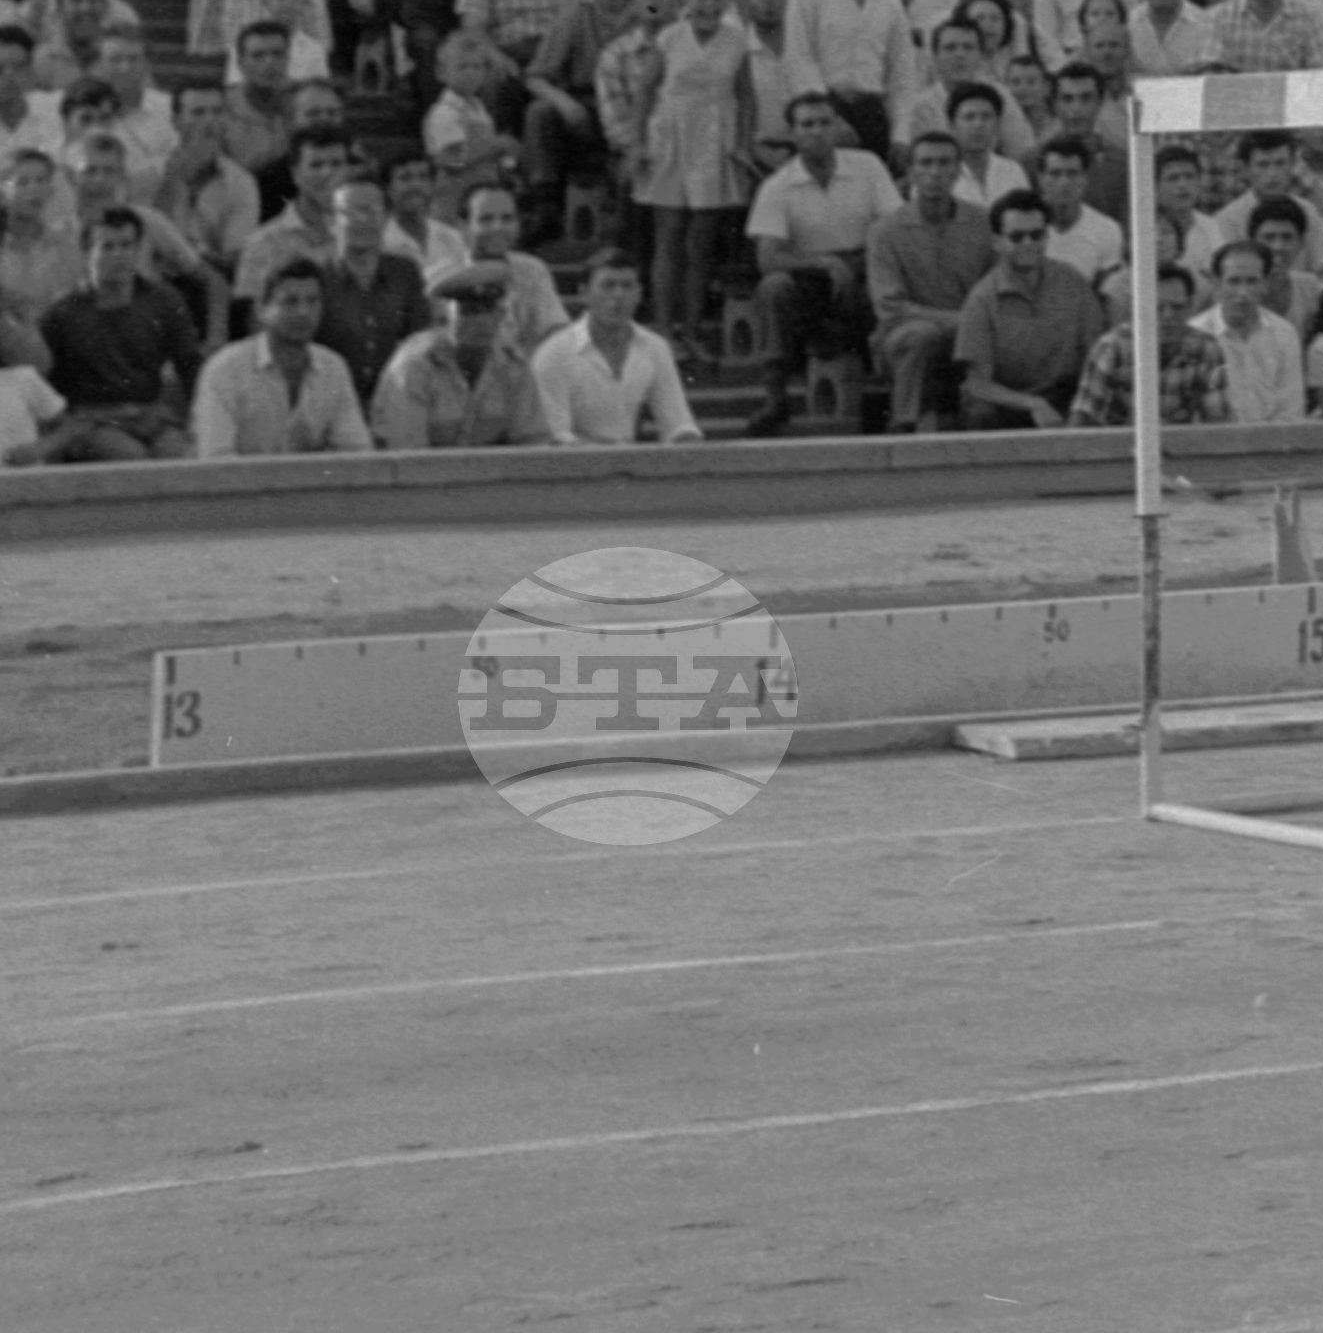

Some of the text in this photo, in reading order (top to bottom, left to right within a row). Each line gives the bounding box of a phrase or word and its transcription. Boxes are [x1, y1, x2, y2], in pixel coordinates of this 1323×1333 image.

[163, 690, 202, 740] 13
[755, 657, 797, 706] 14
[1043, 618, 1070, 644] 50
